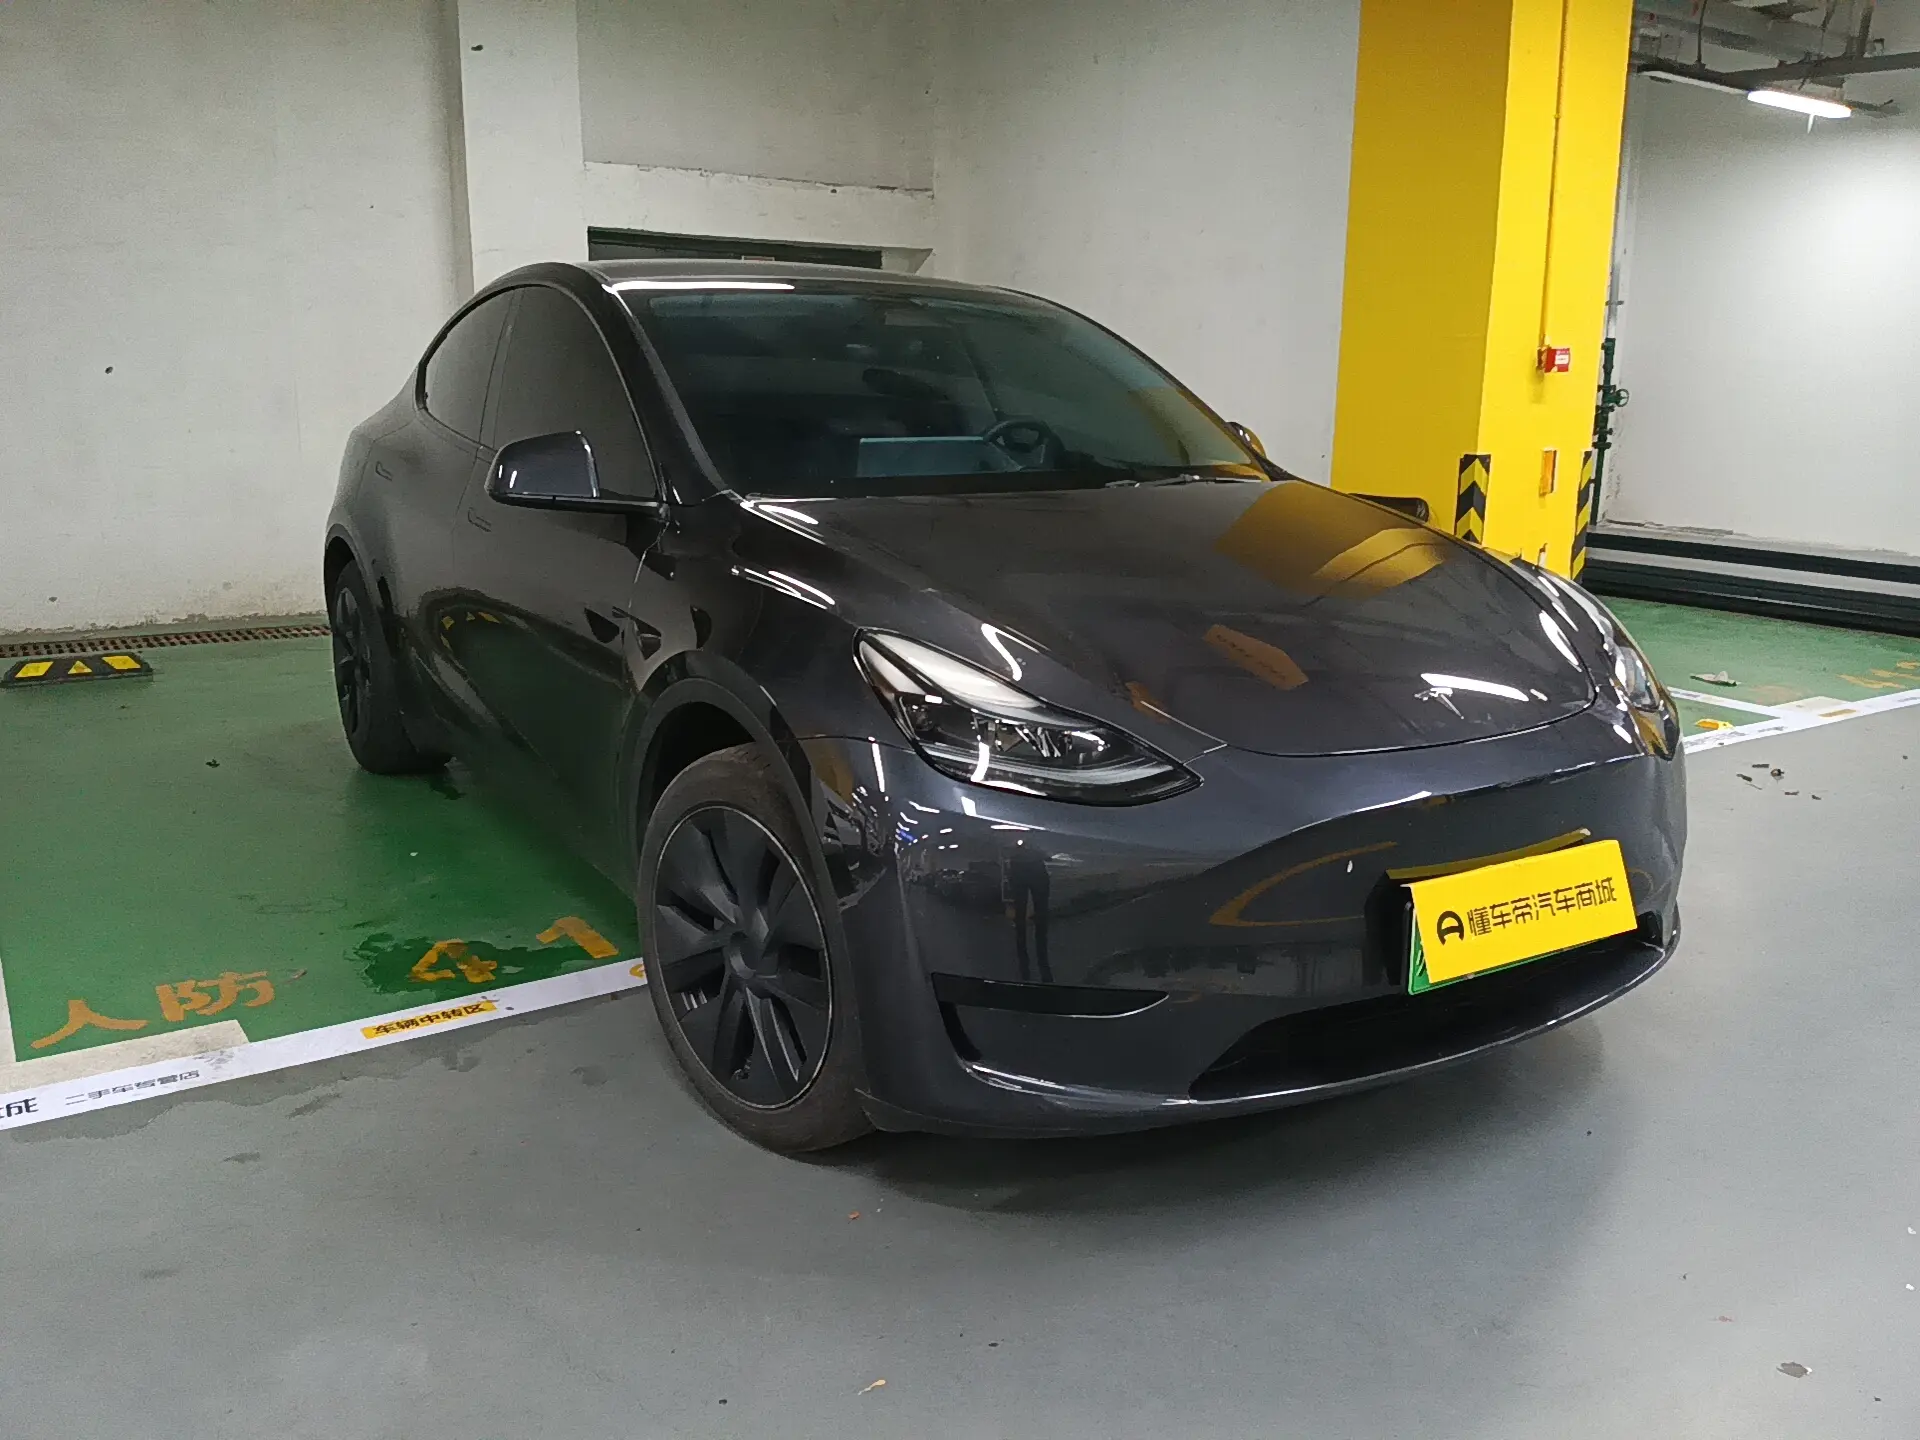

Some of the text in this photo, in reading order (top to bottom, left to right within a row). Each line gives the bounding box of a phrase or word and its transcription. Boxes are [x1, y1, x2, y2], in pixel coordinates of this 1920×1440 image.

[1466, 876, 1618, 937] 懂车帝汽车商城
[30, 970, 277, 1049] 人防
[374, 1002, 485, 1034] 车辆中转区
[65, 1069, 200, 1106] 二手车专营店
